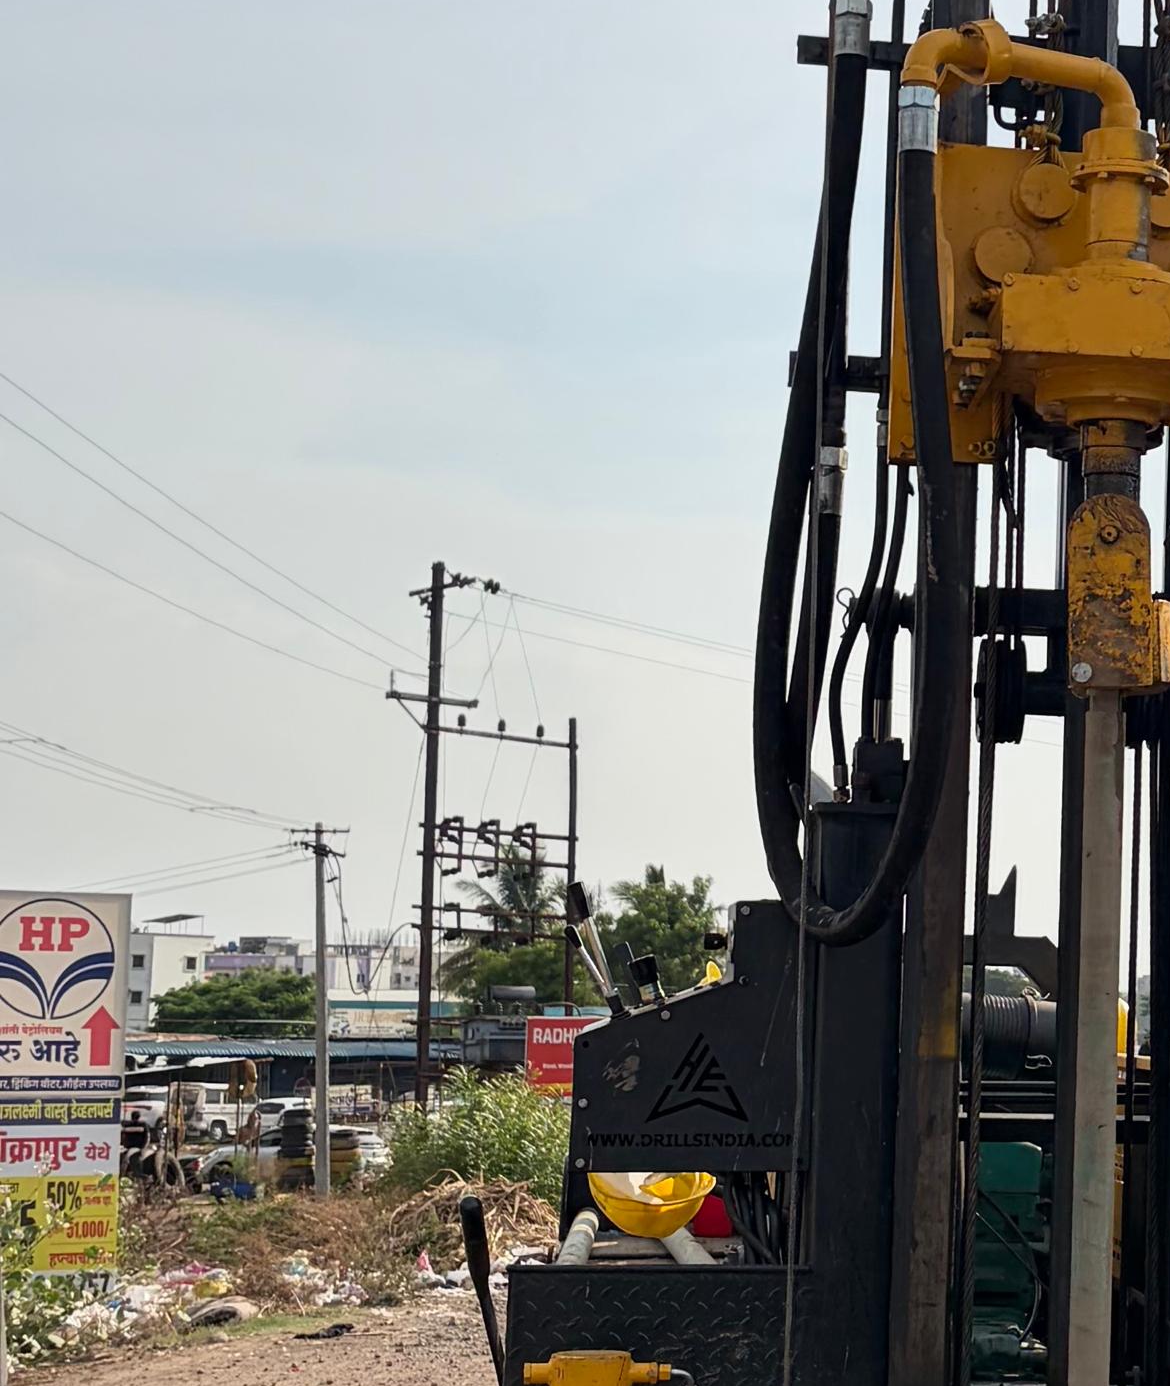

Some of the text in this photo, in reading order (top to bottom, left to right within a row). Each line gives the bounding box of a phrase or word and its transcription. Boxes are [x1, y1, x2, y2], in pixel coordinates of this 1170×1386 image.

[19, 916, 90, 952] HP
[30, 1031, 81, 1068] आहे
[44, 1103, 68, 1124] वास्तु
[71, 1099, 114, 1118] डेव्हलपर्स
[84, 1142, 111, 1160] येथे
[46, 1180, 82, 1211] 50%
